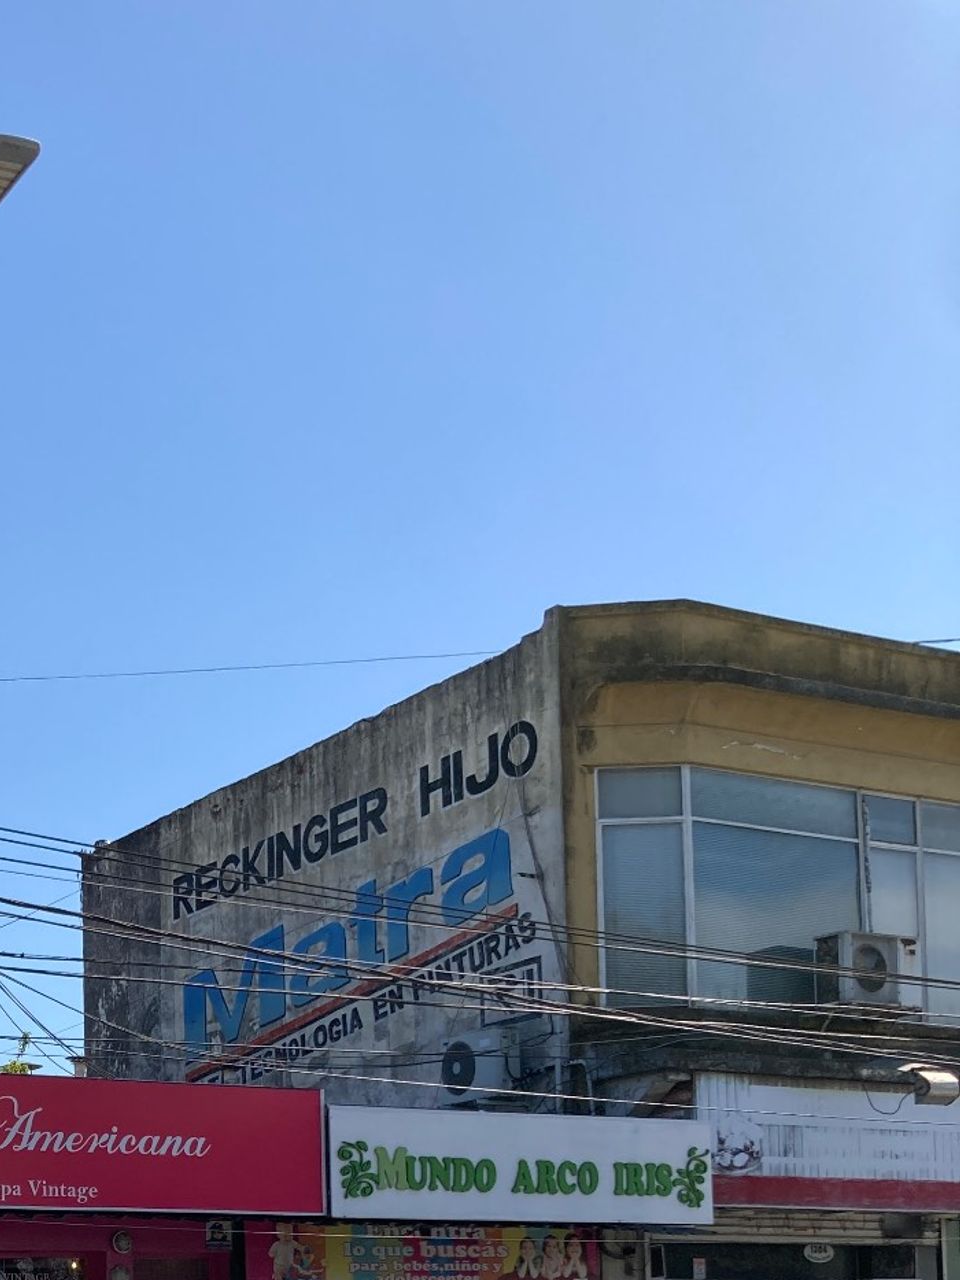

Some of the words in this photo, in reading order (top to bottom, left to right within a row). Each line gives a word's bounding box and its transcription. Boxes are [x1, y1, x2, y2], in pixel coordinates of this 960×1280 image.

[172, 786, 388, 920] RECKINGER
[419, 720, 538, 818] HIJO
[183, 826, 514, 1056] Matra
[373, 982, 405, 1022] EN
[411, 912, 536, 1001] PINTURAS
[28, 1179, 98, 1203] Vintage
[374, 1146, 497, 1192] MUNDO
[510, 1159, 599, 1196] ARCO
[612, 1161, 673, 1196] IRIS
[344, 1242, 365, 1257] lo
[372, 1244, 414, 1260] que
[419, 1240, 508, 1258] buscás
[350, 1262, 387, 1273] para
[492, 1262, 503, 1274] y
